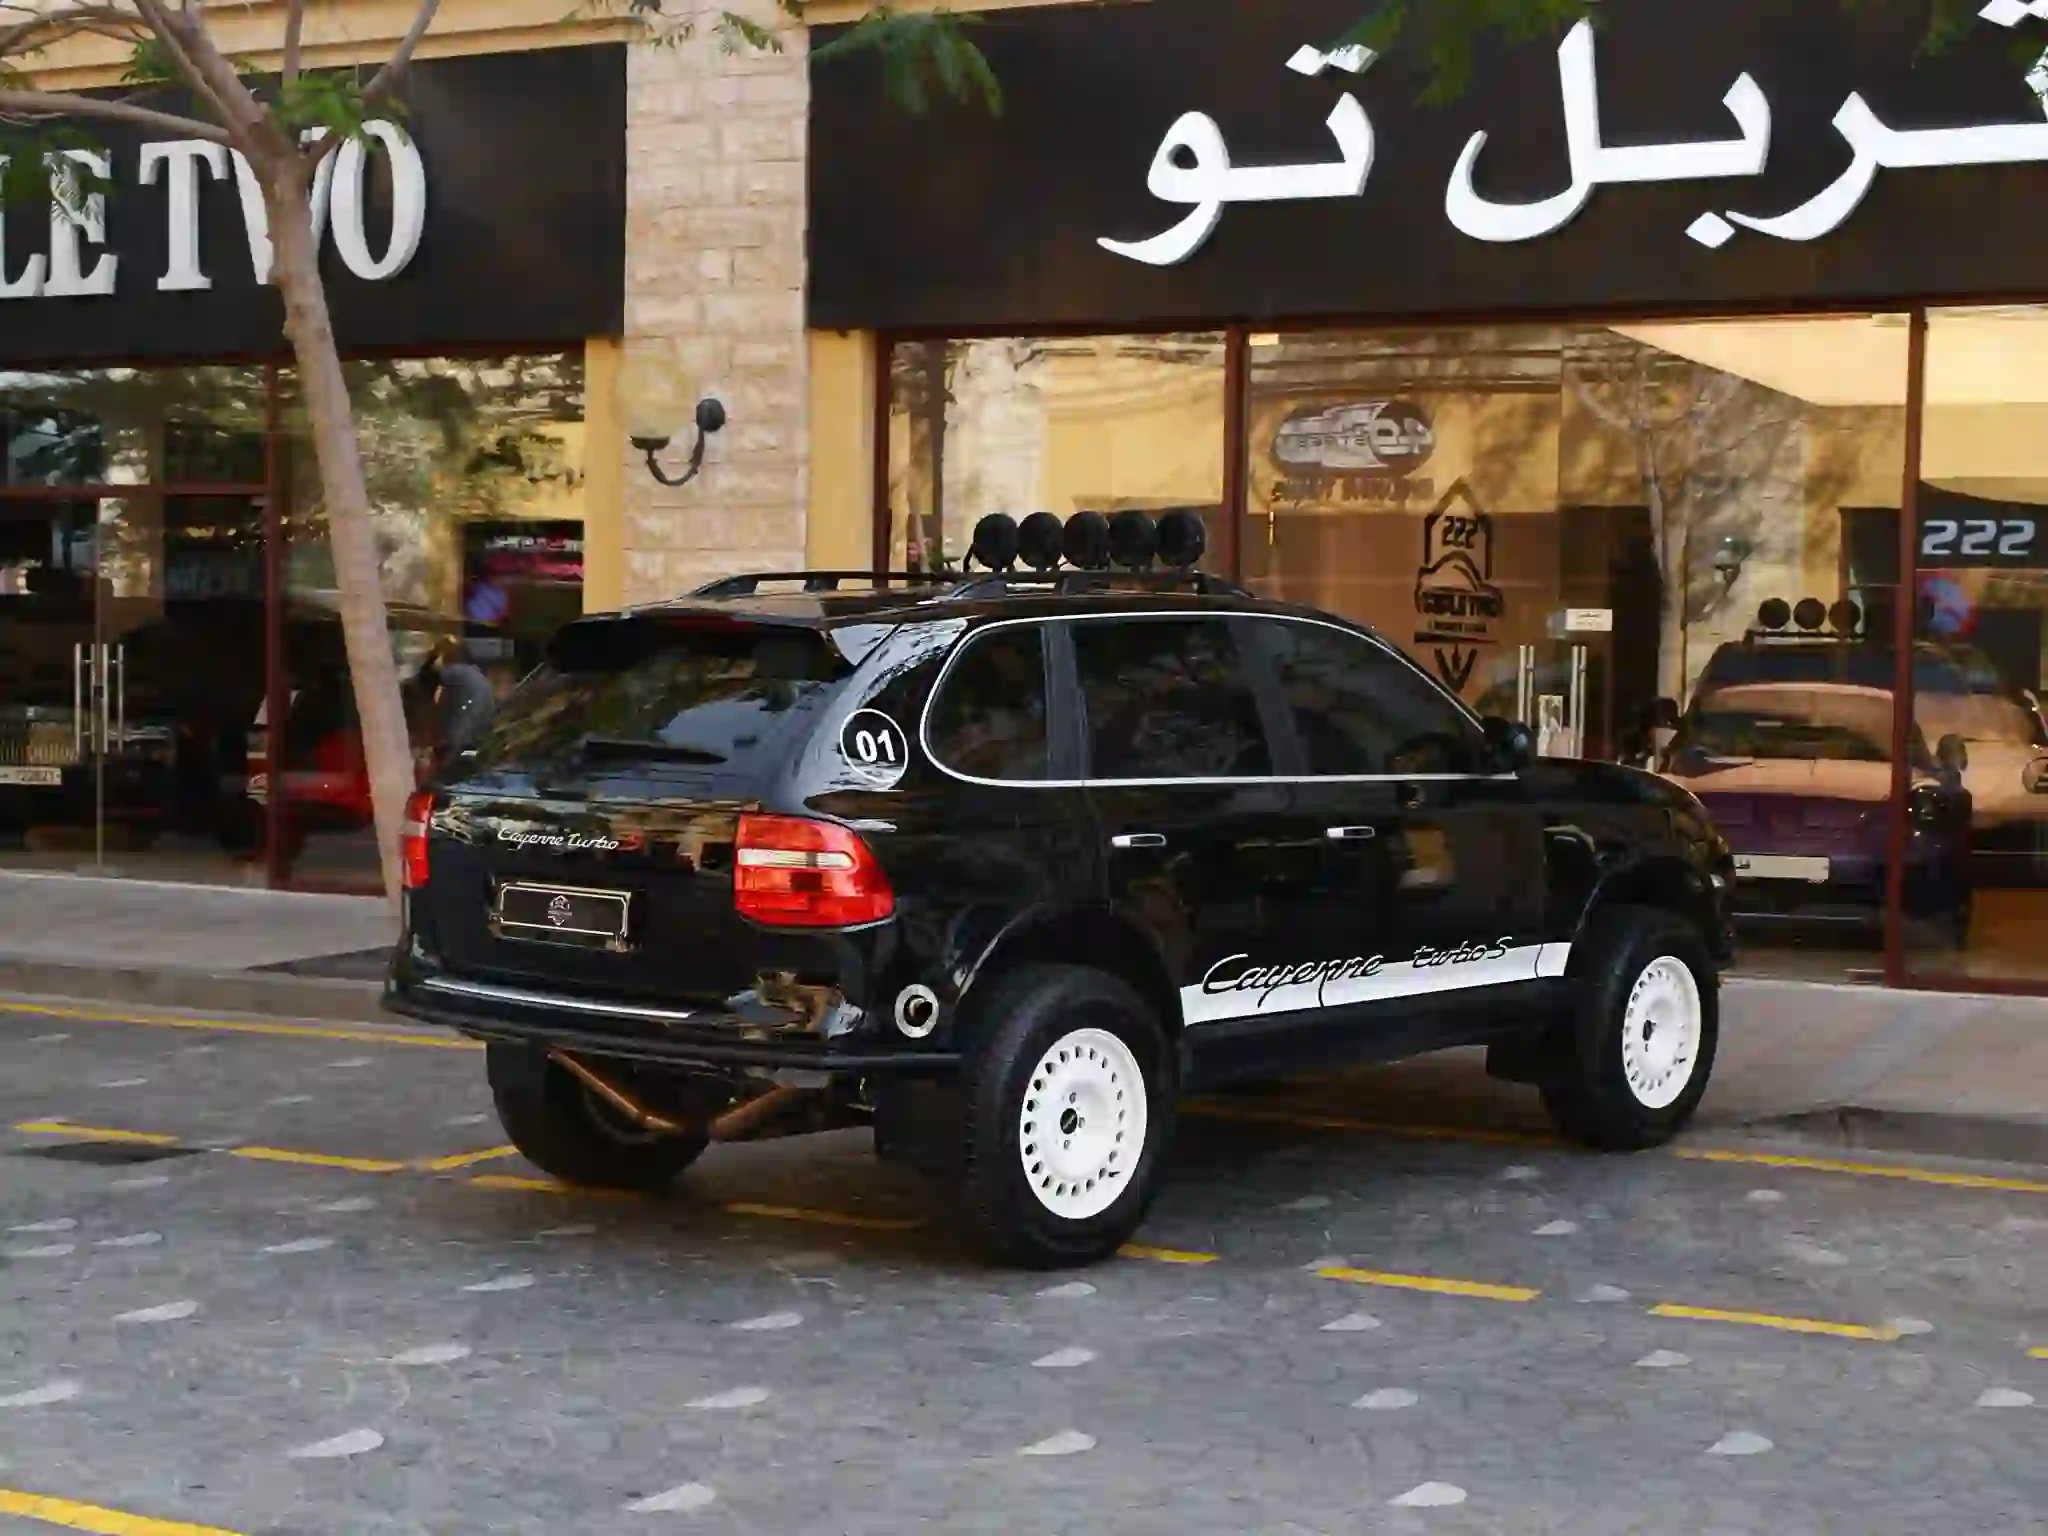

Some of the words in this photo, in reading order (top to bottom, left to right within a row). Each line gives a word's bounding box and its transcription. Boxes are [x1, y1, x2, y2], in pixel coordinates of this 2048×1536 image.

[1096, 43, 1378, 266] تو
[1921, 519, 2036, 556] 222
[856, 729, 896, 763] 01
[497, 828, 563, 850] Cayenne
[1202, 953, 1383, 1008] Cayenne
